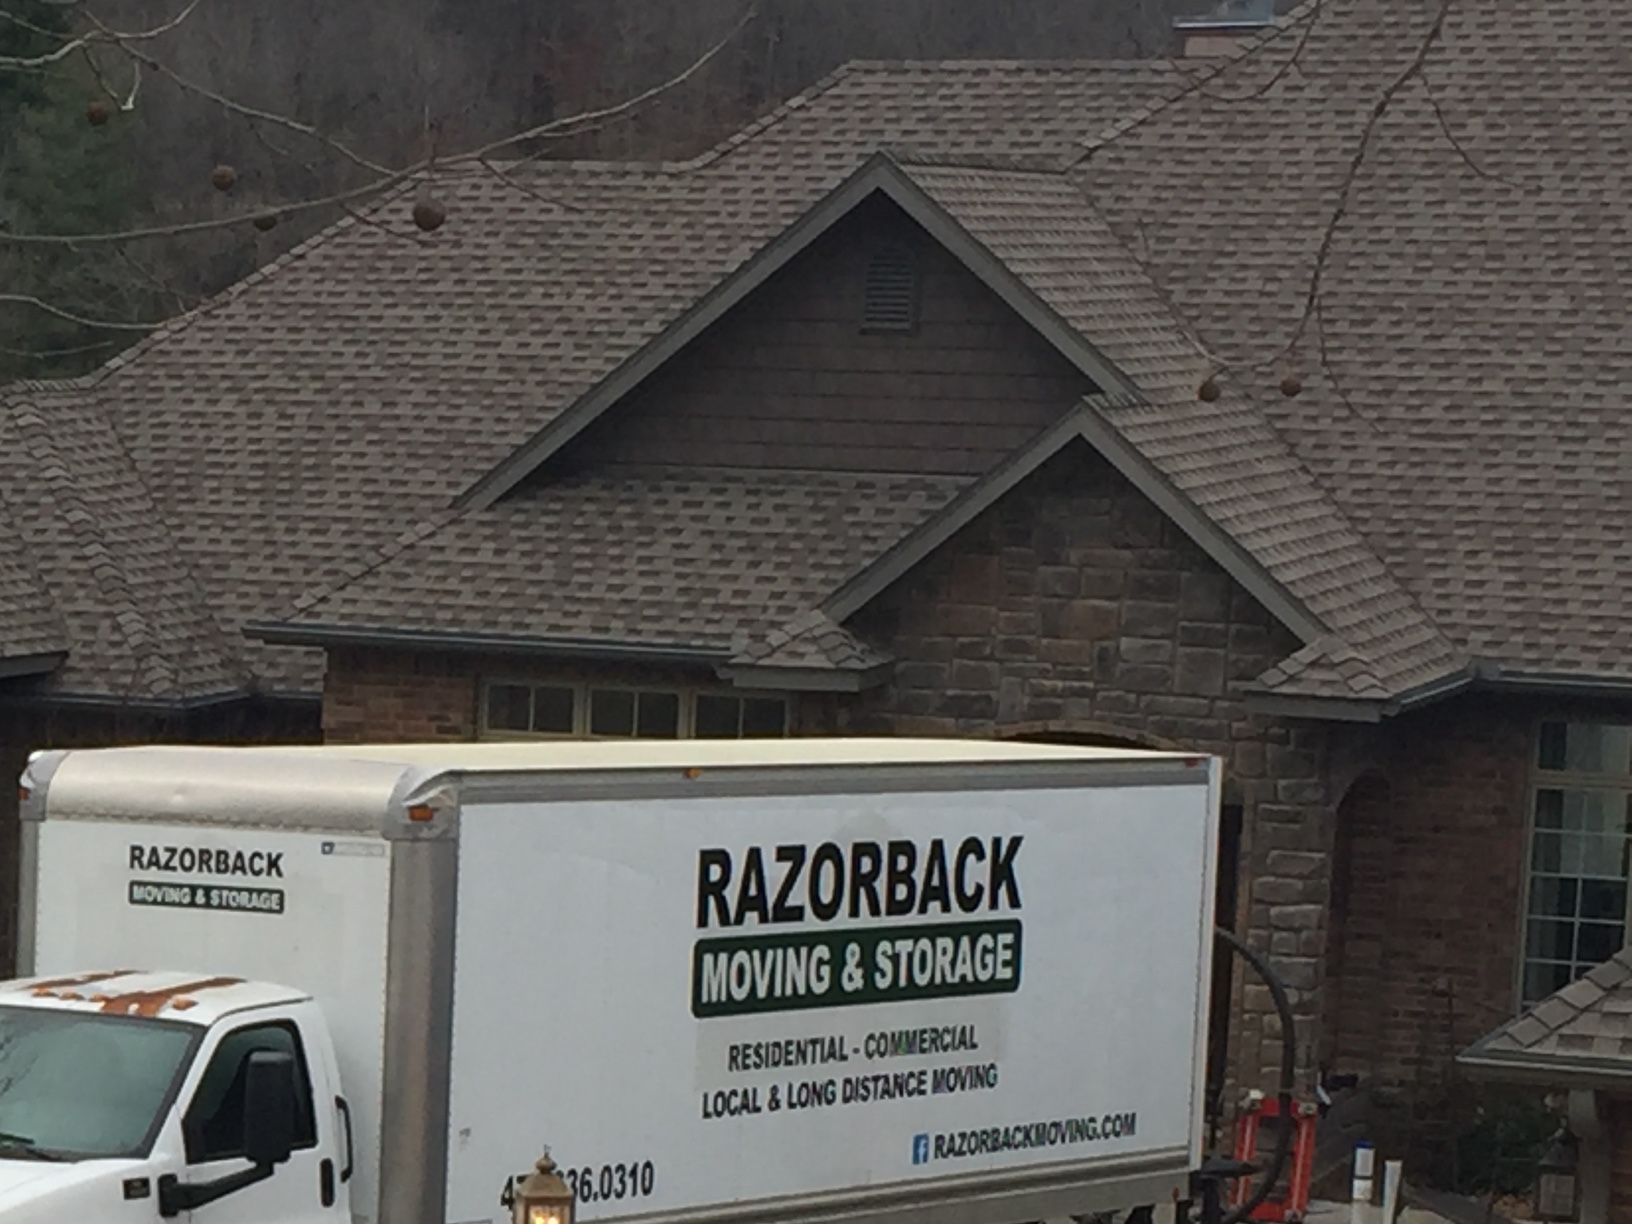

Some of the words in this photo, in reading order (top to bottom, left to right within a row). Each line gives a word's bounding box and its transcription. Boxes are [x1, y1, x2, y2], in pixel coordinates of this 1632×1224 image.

[129, 844, 285, 878] RAZORBACK
[696, 835, 1024, 929] RAZORBACK
[132, 884, 191, 904] MOVING
[195, 888, 206, 905] &
[210, 889, 281, 910] STORAGE
[701, 944, 831, 1003] MOVING
[841, 942, 865, 993] &
[874, 932, 1015, 990] STORAGE
[728, 1035, 849, 1072] RESIDENTIAL
[864, 1024, 979, 1060] COMMERCIAL
[702, 1085, 762, 1119] LOCAL
[767, 1083, 782, 1112] &
[787, 1078, 837, 1110] LONG
[841, 1070, 927, 1104] DISTANCE
[931, 1062, 998, 1094] MOVING
[934, 1112, 1137, 1159] RAZORBACKMOVING.COM
